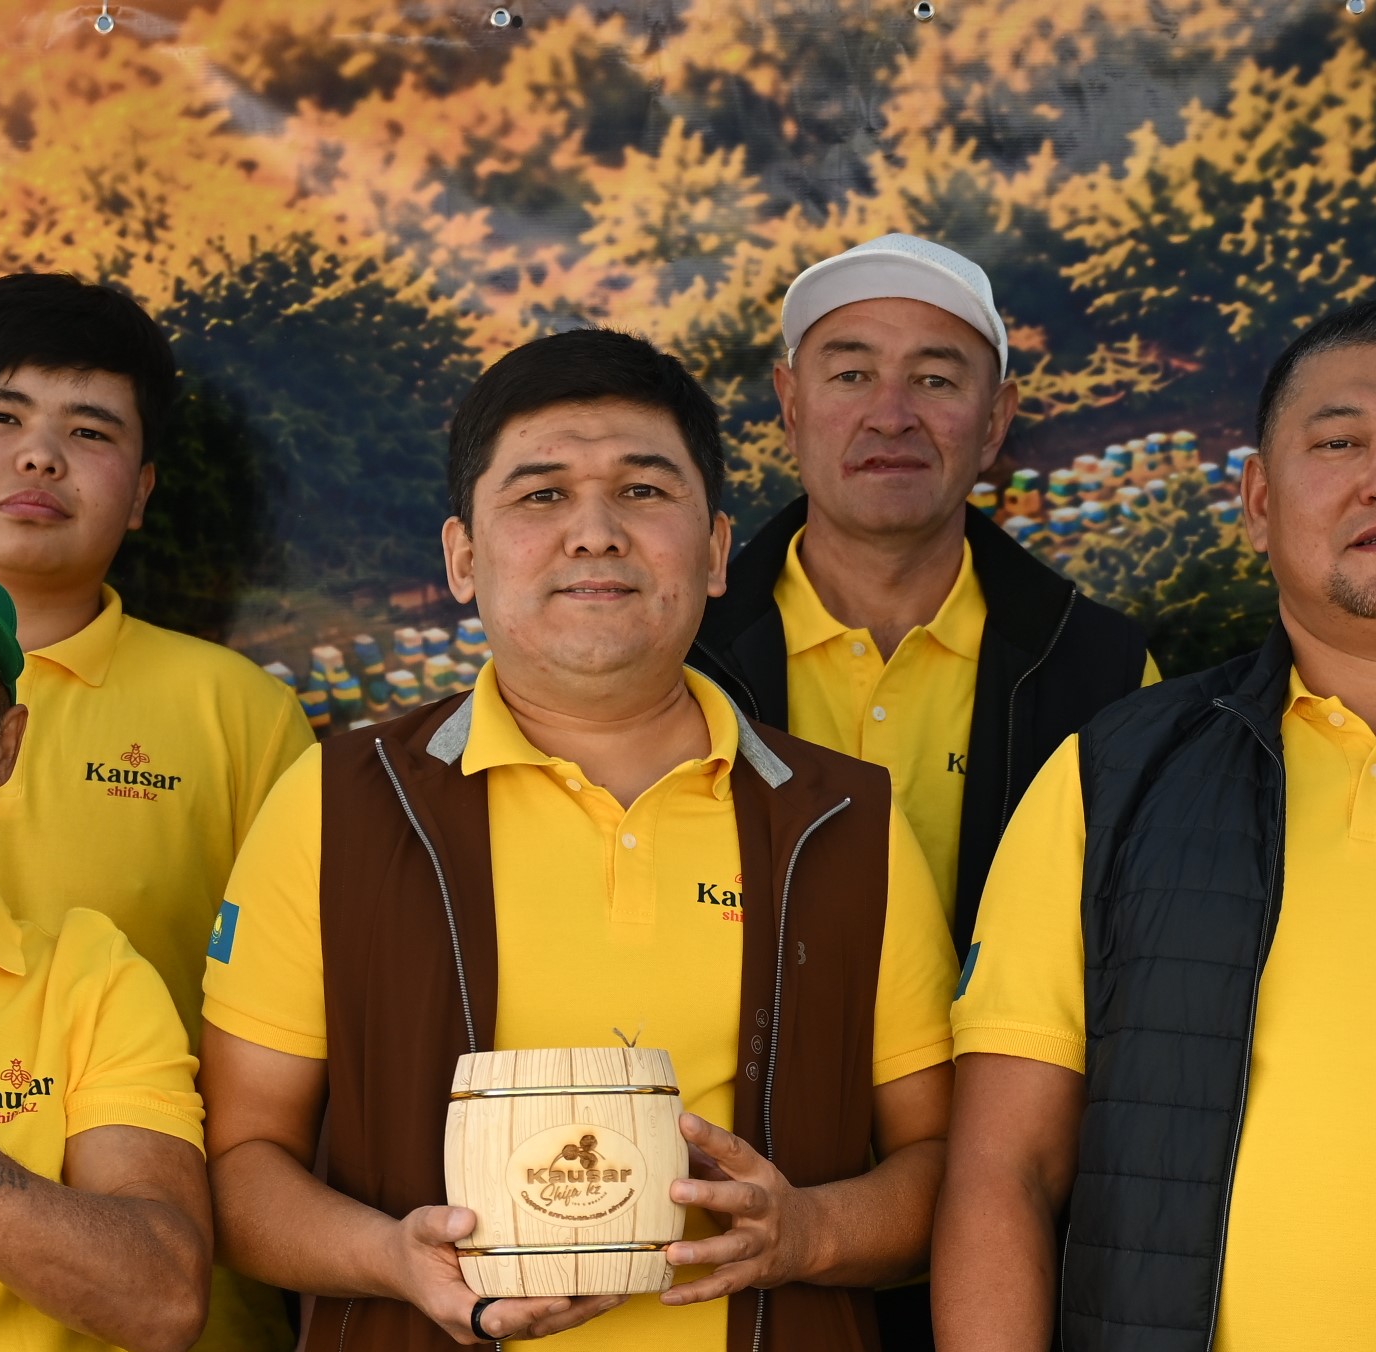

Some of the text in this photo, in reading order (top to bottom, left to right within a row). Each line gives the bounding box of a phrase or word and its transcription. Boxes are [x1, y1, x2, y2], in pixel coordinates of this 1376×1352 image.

[85, 762, 182, 791] Kausar
[107, 785, 158, 802] shifa.kz
[526, 1168, 632, 1185] Kausar
